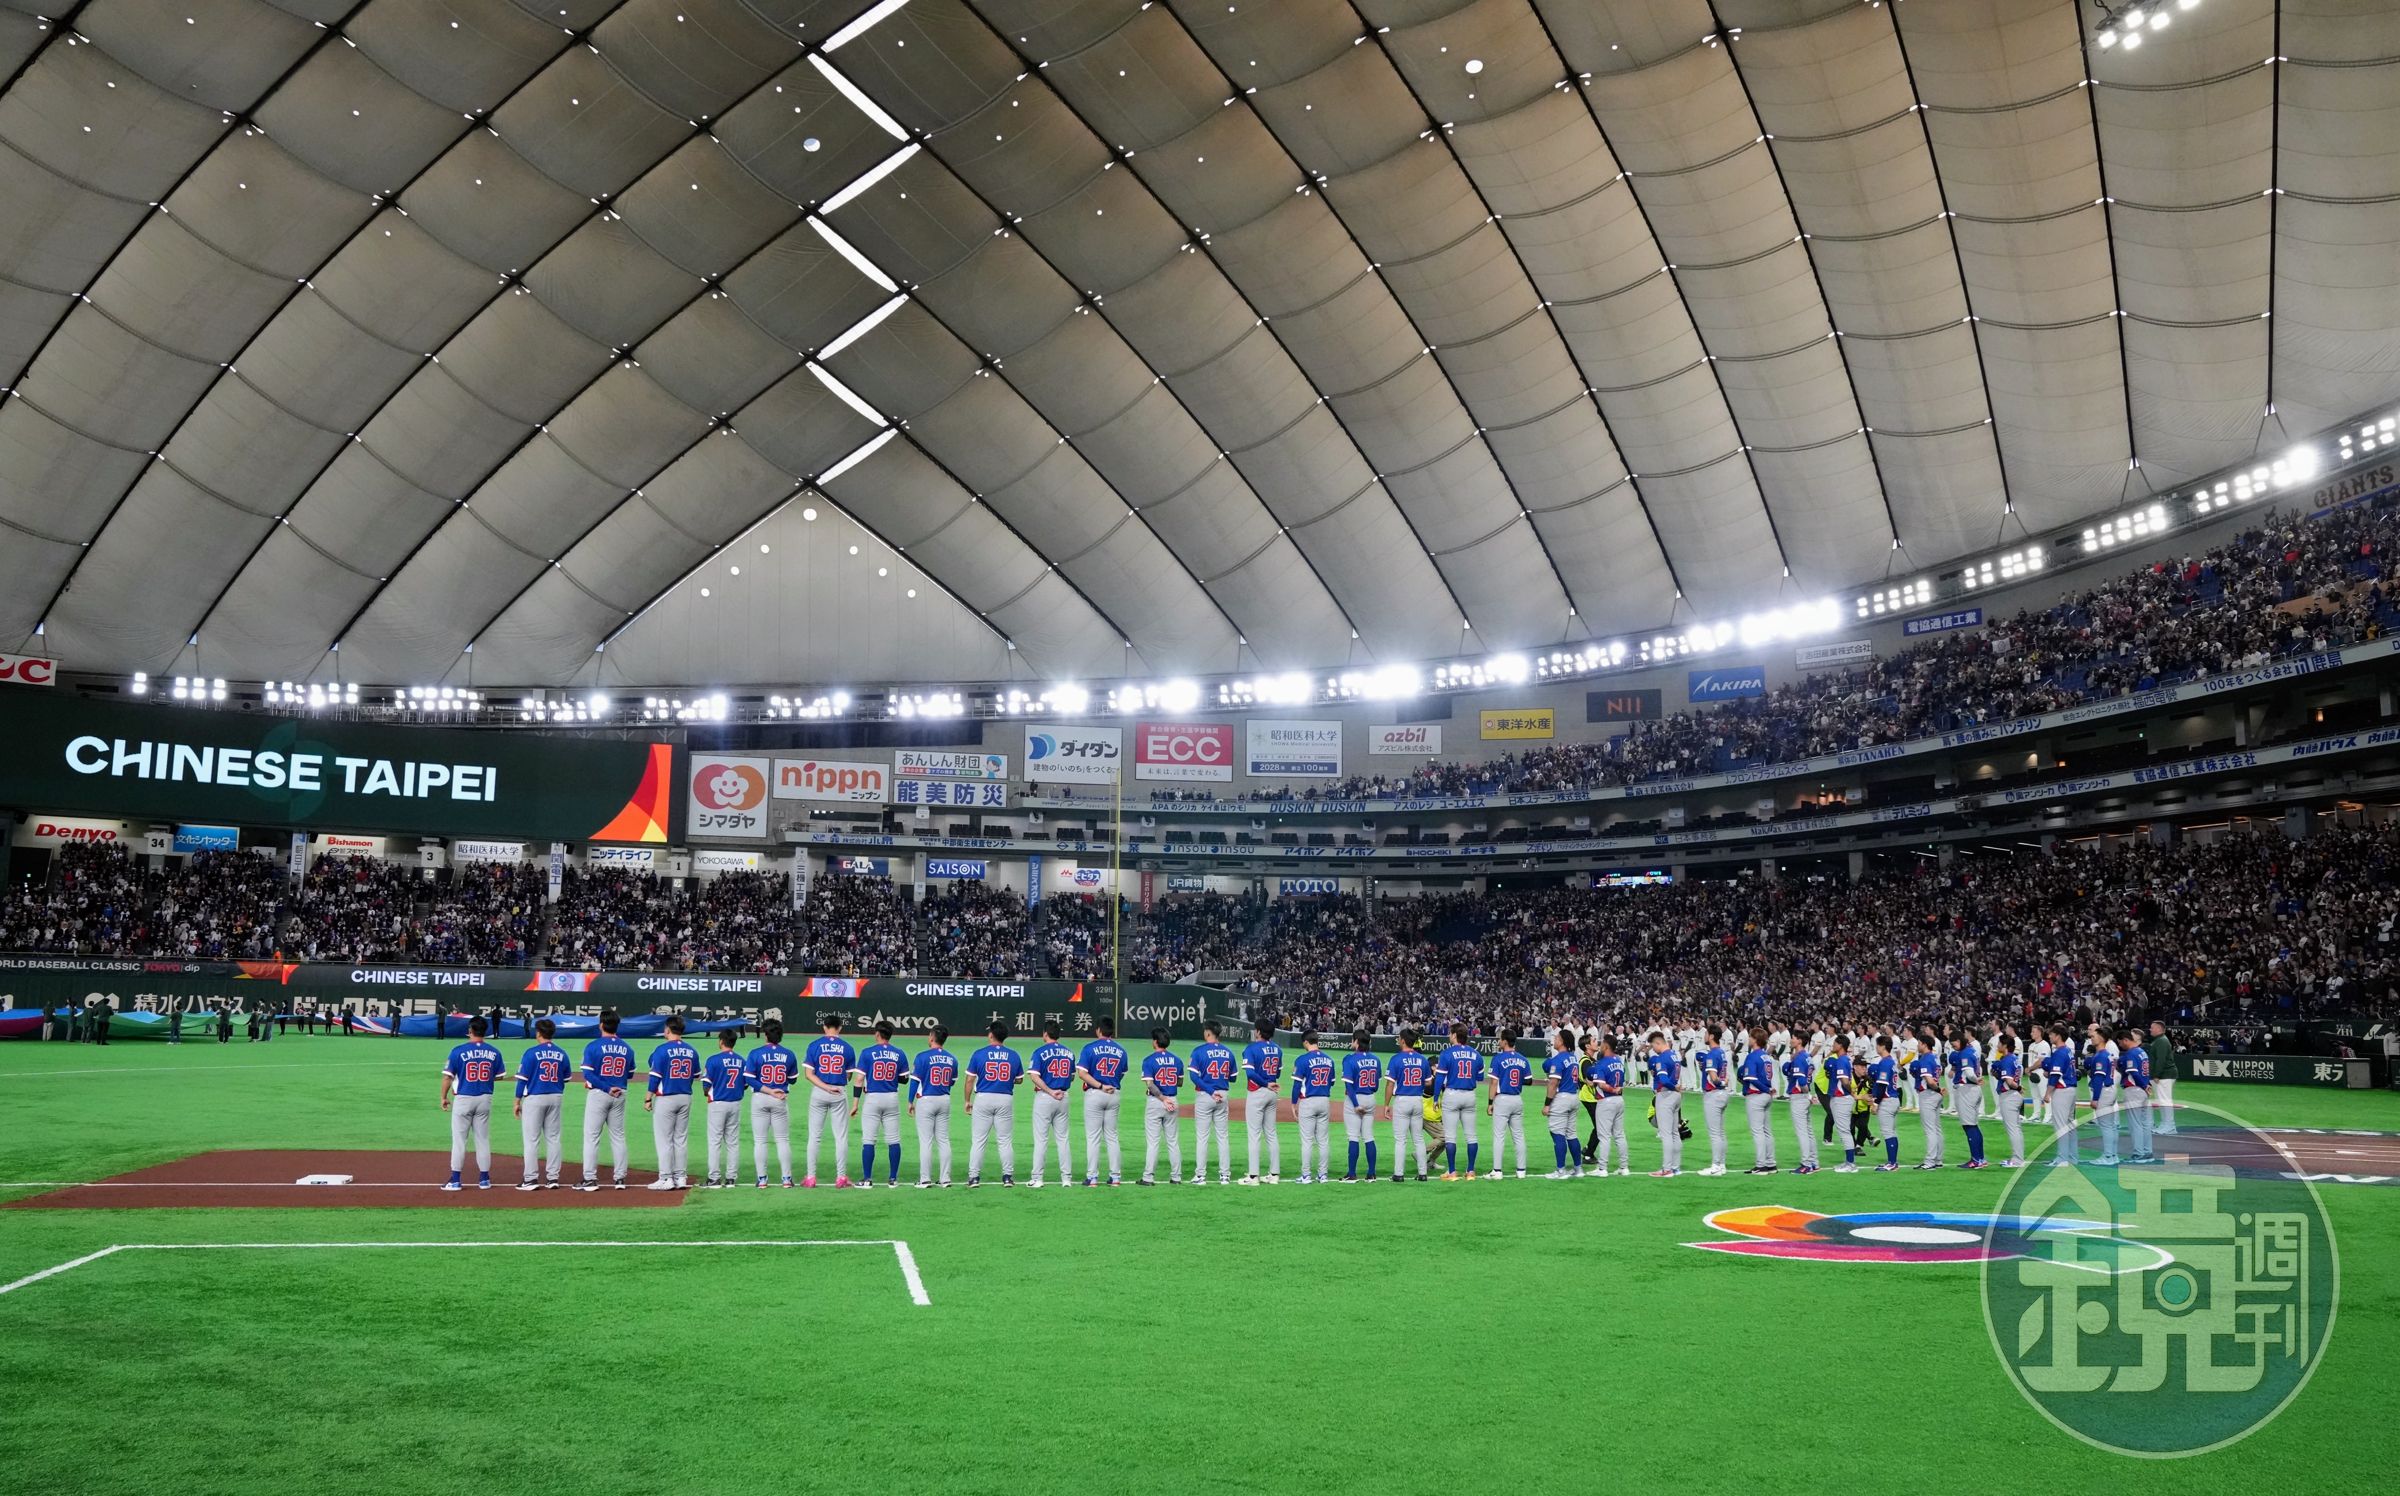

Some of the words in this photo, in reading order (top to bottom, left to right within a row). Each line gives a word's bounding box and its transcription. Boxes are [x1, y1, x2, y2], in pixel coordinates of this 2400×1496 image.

[2314, 465, 2394, 508] GIANTS
[1908, 612, 1977, 633] 電協通信工業
[2203, 663, 2293, 692] 100年をつくる会社
[1497, 718, 1551, 730] 東洋水産
[1270, 730, 1337, 741] 昭和医科大学
[1384, 727, 1426, 743] azbil
[1060, 740, 1119, 759] ダイダン
[1147, 735, 1221, 762] ECC
[2293, 735, 2357, 757] 内藤ハウス
[66, 736, 323, 791] CHINESE
[336, 756, 497, 802] TAIPEI
[902, 753, 981, 769] あんしん財団
[2133, 753, 2257, 783] 電協通信工業株式会社
[781, 762, 882, 793] nippn
[851, 791, 881, 800] ニップン
[897, 781, 1003, 806] 能美防災
[1151, 803, 1169, 811] APA
[1270, 802, 1314, 813] DUSKIN
[1321, 802, 1366, 813] DUSKIN
[699, 814, 756, 829] シマダヤ
[35, 823, 117, 842] Denyo
[327, 836, 373, 847] Bishamon
[151, 838, 165, 848] 34
[458, 844, 519, 856] 昭和医科大学
[1283, 847, 1325, 856] アイホン
[1335, 847, 1376, 856] アイホン
[426, 852, 434, 861] 3
[591, 849, 652, 861] ニッテイライフ
[697, 857, 745, 866] YOKOGAWA
[550, 853, 563, 886] 関電工
[928, 863, 981, 876] SAISON
[1169, 878, 1203, 888] JR貨物
[1282, 879, 1337, 893] TOTO
[0, 959, 26, 968] RLD
[28, 960, 89, 970] BASEBALL
[91, 961, 141, 971] CLASSIC
[144, 963, 181, 972] TOKYO
[184, 963, 200, 973] dip
[351, 970, 428, 985] CHINESE
[432, 972, 485, 986] TAIPEI
[637, 977, 709, 992] CHINESE
[712, 979, 762, 993] TAIPEI
[905, 983, 974, 997] CHINESE
[977, 985, 1025, 998] TAIPEI
[858, 1010, 940, 1029] SANKYO
[1124, 998, 1196, 1027] kewpie
[460, 1049, 497, 1062] C.M.CHANG
[819, 1054, 845, 1075] 92
[465, 1061, 491, 1082] 66
[539, 1061, 559, 1083] 31
[600, 1056, 626, 1077] 28
[670, 1058, 692, 1079] 23
[760, 1064, 787, 1084] 96
[872, 1061, 897, 1082] 88
[985, 1061, 1012, 1082] 58
[1047, 1058, 1070, 1079] 48
[1096, 1057, 1121, 1078] 47
[1206, 1060, 1230, 1080] 44
[1457, 1060, 1473, 1079] 11
[2233, 1060, 2275, 1071] NIPPON
[2233, 1070, 2275, 1080] EXPRESS
[726, 1068, 739, 1089] 7
[930, 1066, 953, 1087] 60
[1154, 1067, 1178, 1087] 45
[1311, 1068, 1331, 1087] 37
[1359, 1069, 1377, 1089] 20
[1402, 1068, 1422, 1087] 12
[1509, 1068, 1520, 1087] 9
